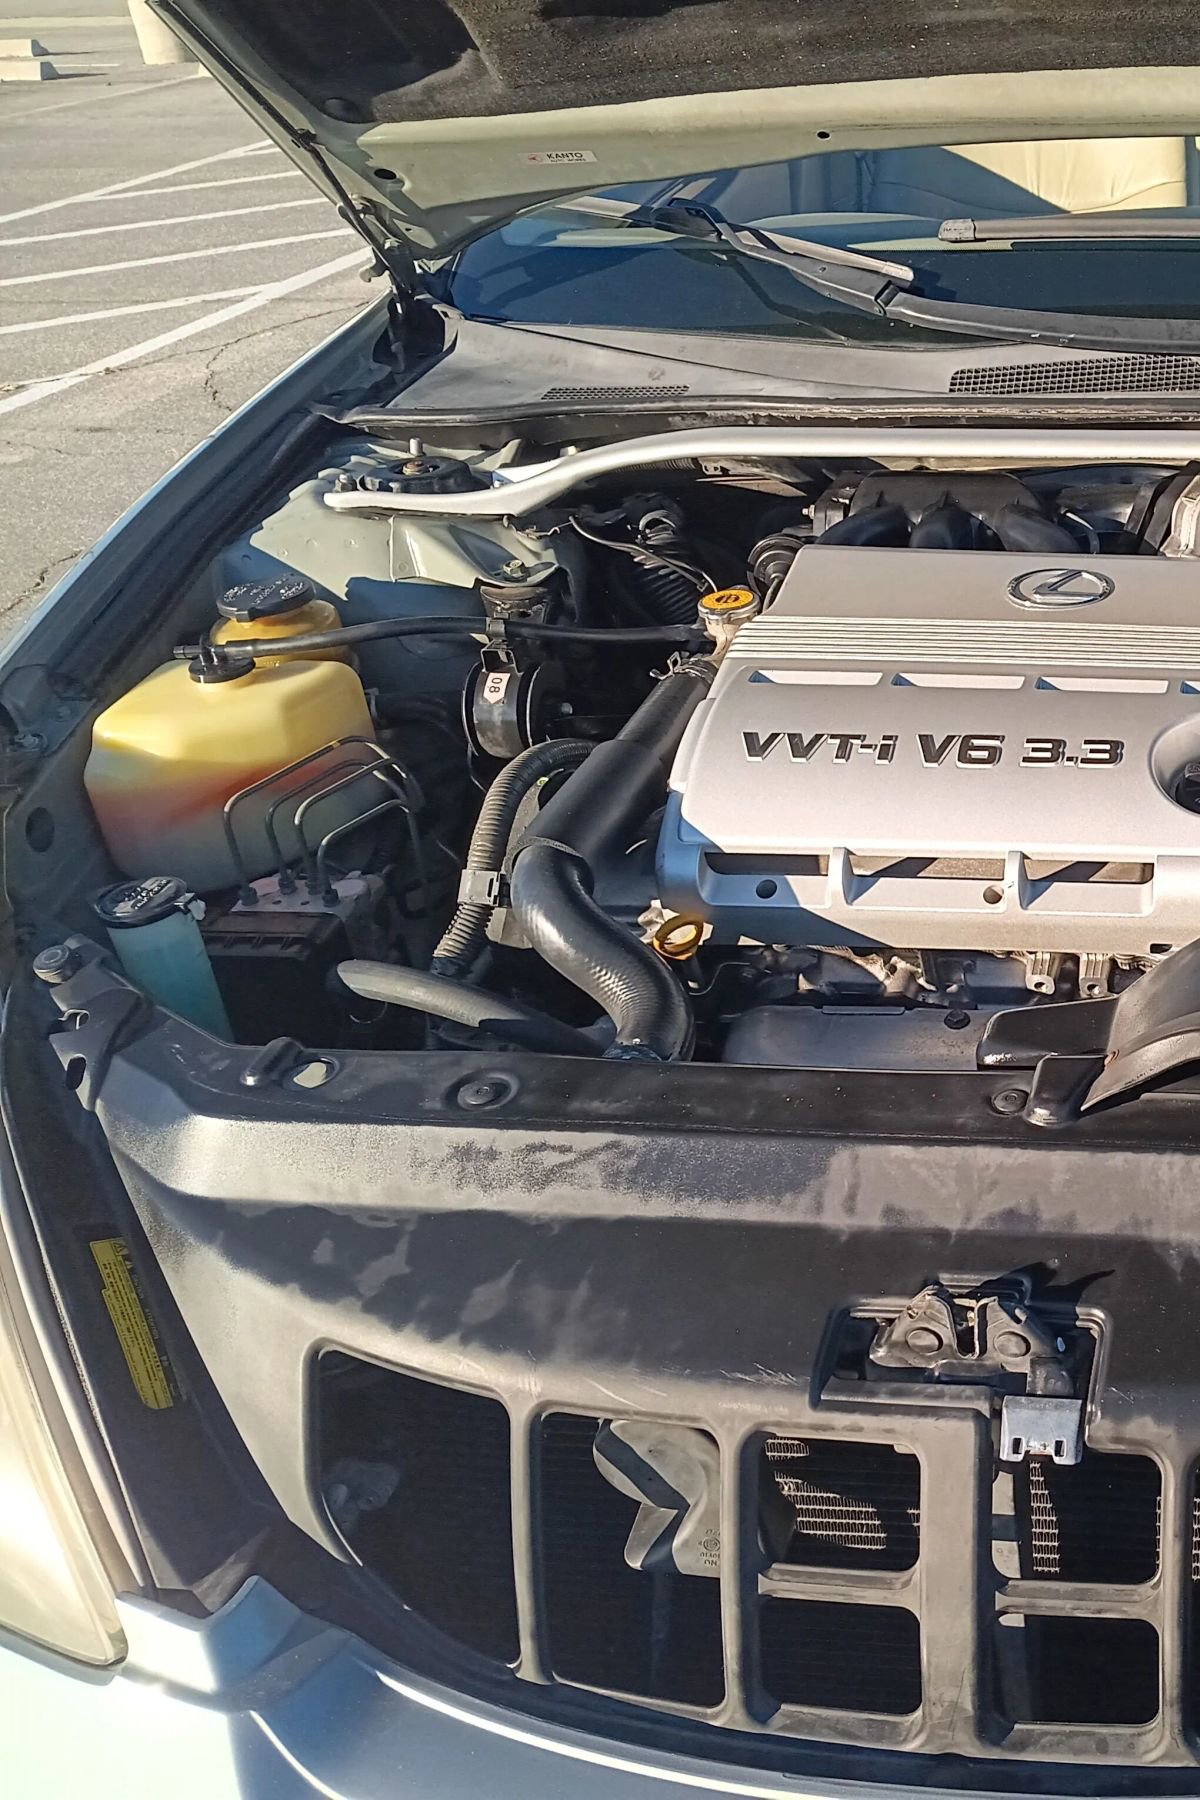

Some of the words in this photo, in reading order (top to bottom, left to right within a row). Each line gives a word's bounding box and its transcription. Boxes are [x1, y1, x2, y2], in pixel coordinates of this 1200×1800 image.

[742, 731, 900, 765] VVT-i
[916, 734, 1006, 769] V6
[1018, 737, 1126, 769] 3.3
